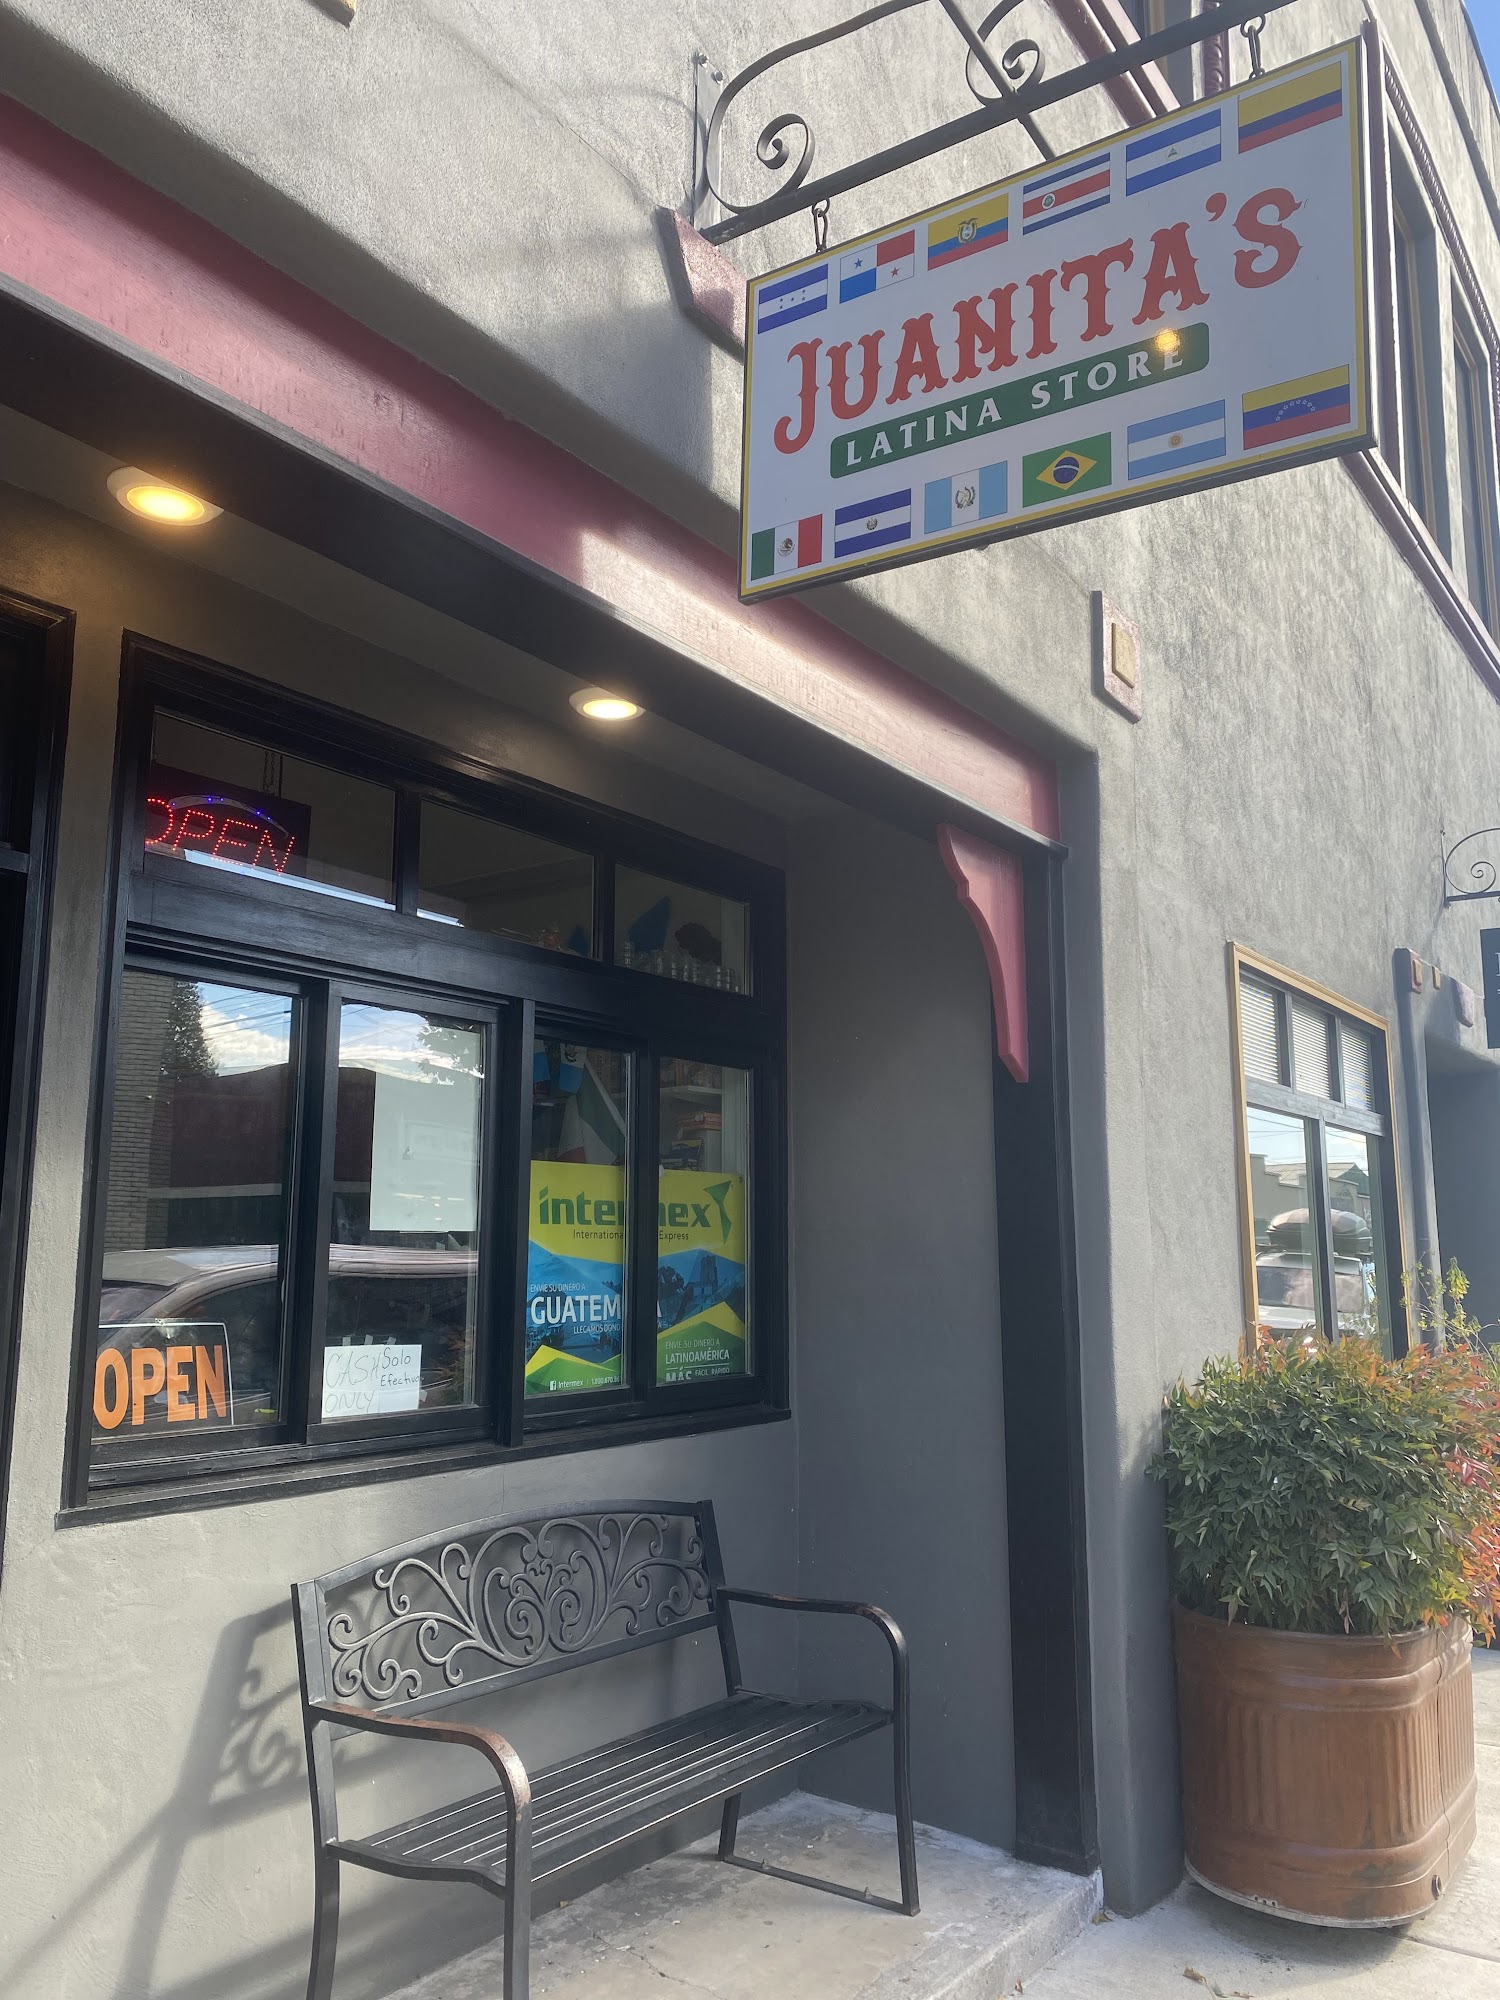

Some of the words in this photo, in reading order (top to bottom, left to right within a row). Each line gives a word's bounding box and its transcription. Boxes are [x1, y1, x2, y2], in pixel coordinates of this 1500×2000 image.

[773, 187, 1305, 455] JUANITA'S
[846, 397, 1003, 467] LATINA
[1030, 347, 1183, 409] STORE
[573, 1229, 624, 1240] Internationa
[659, 1231, 689, 1242] Express
[549, 1283, 557, 1292] SU
[558, 1283, 580, 1292] DINERO
[581, 1283, 586, 1291] A
[665, 1340, 682, 1350] ENVIE
[684, 1340, 692, 1349] SU
[693, 1339, 715, 1348] DINERO
[715, 1338, 721, 1346] A
[665, 1347, 730, 1365] LATINOAMÉRICA
[326, 1351, 382, 1388] CASH
[382, 1346, 412, 1370] Solo
[93, 1345, 227, 1430] OPEN
[558, 1380, 584, 1389] Intermex
[324, 1390, 375, 1414] ONLY
